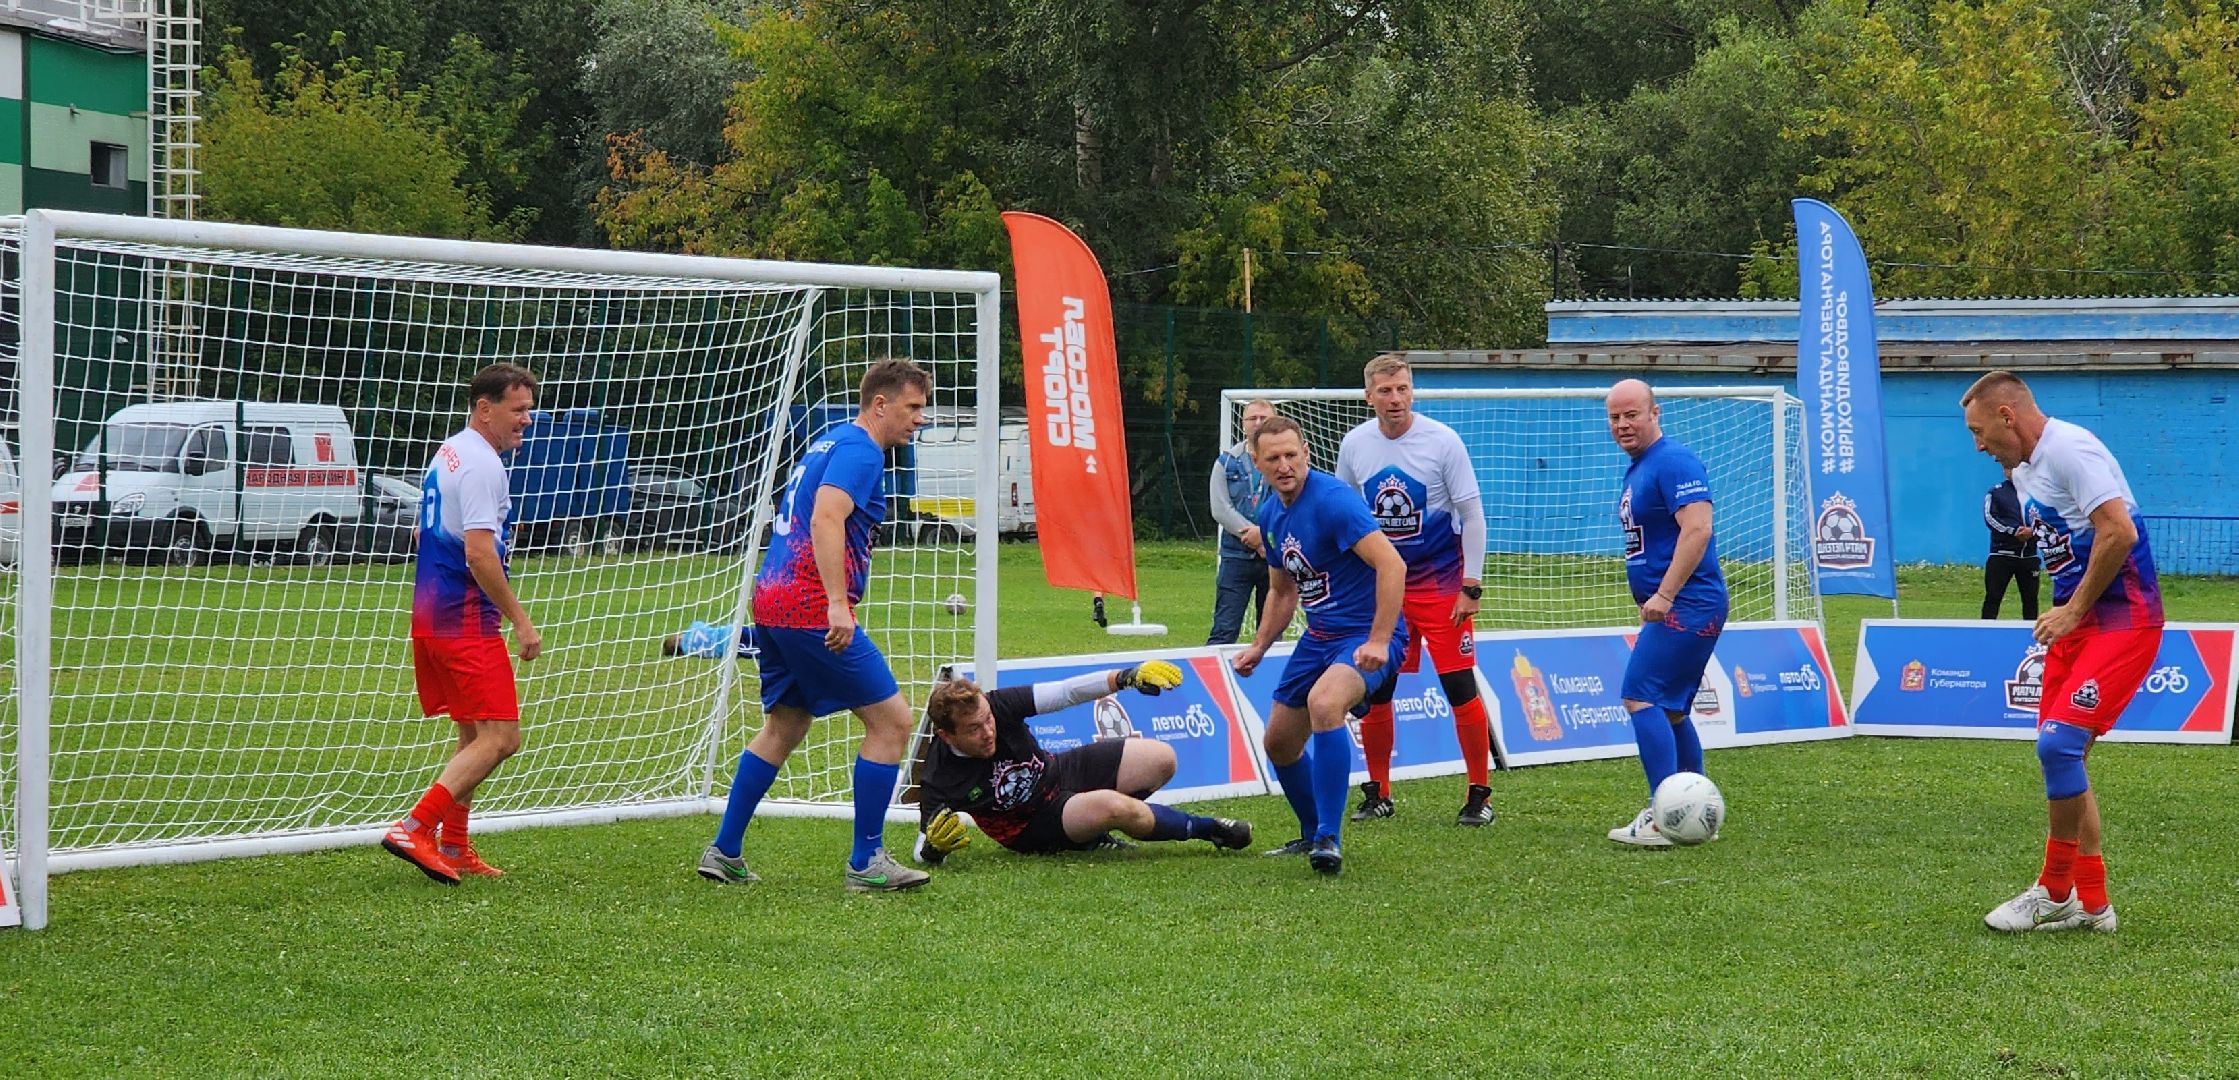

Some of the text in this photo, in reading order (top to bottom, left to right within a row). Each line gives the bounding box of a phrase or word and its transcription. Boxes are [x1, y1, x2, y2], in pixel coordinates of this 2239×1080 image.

[1931, 668, 1970, 678] Команда
[1549, 673, 1604, 696] Команда
[1929, 678, 1987, 689] Губернатора
[1151, 715, 1186, 732] лето
